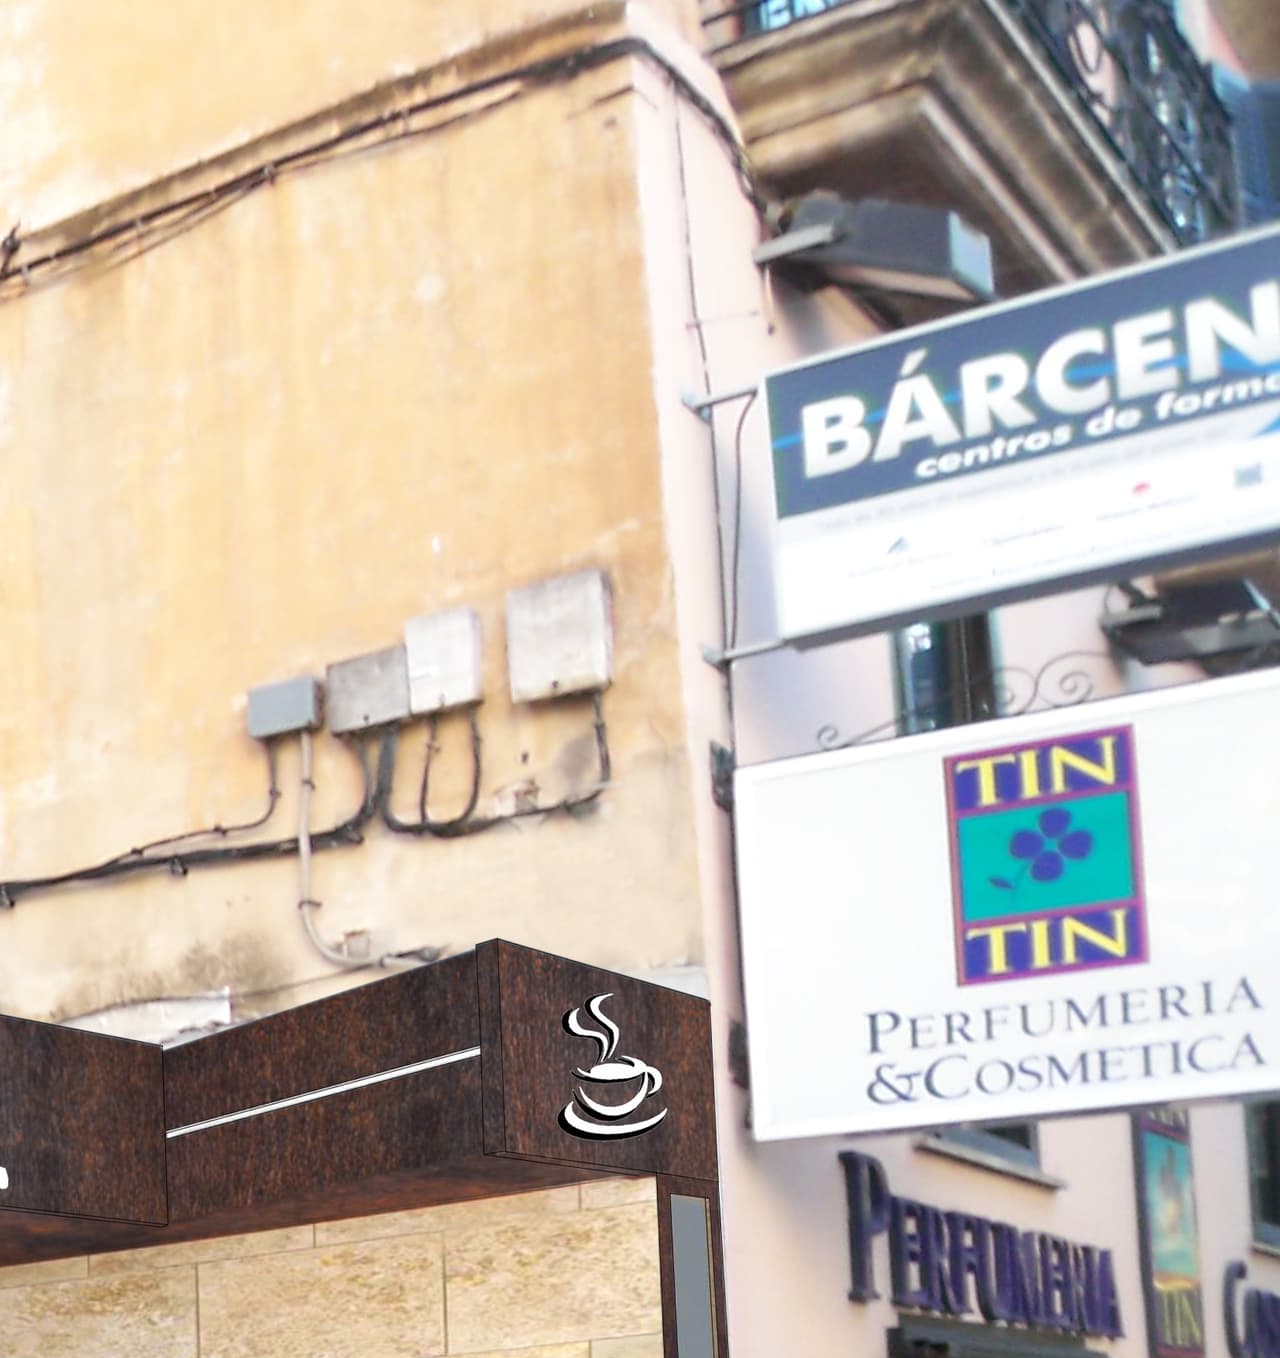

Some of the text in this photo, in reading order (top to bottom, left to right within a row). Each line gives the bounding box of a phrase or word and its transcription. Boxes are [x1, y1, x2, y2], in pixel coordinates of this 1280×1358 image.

[913, 421, 1072, 480] centros
[1085, 406, 1141, 437] de
[956, 736, 1119, 807] TIN
[964, 908, 1130, 975] TIN
[865, 976, 1265, 1056] PERFUMERIA
